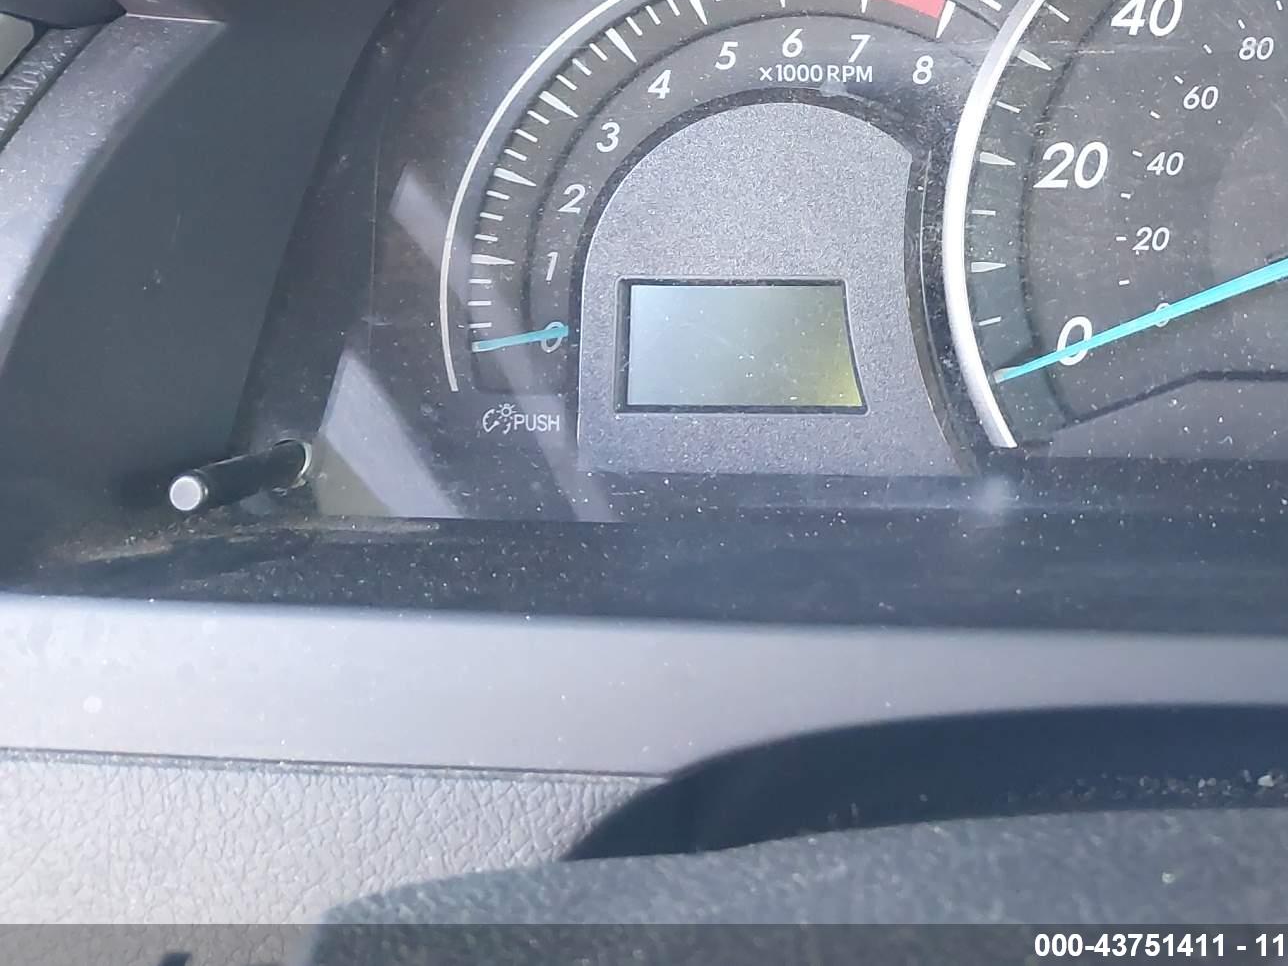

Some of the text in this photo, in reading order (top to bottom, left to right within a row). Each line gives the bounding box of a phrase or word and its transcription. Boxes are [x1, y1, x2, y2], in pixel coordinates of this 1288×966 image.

[714, 41, 739, 70] 5
[782, 28, 803, 58] 6
[848, 34, 871, 63] 7
[1238, 36, 1274, 61] 80
[647, 69, 672, 100] 4
[826, 64, 873, 83] RPM
[912, 54, 934, 85] 8
[1183, 86, 1219, 110] 60
[596, 121, 621, 153] 3
[1033, 141, 1108, 189] 20
[1146, 151, 1185, 176] 40
[559, 183, 586, 214] 2
[1132, 226, 1170, 251] 20
[545, 251, 559, 281] 1
[540, 320, 565, 354] 0
[1056, 315, 1093, 366] 0
[513, 413, 561, 432] PUSH
